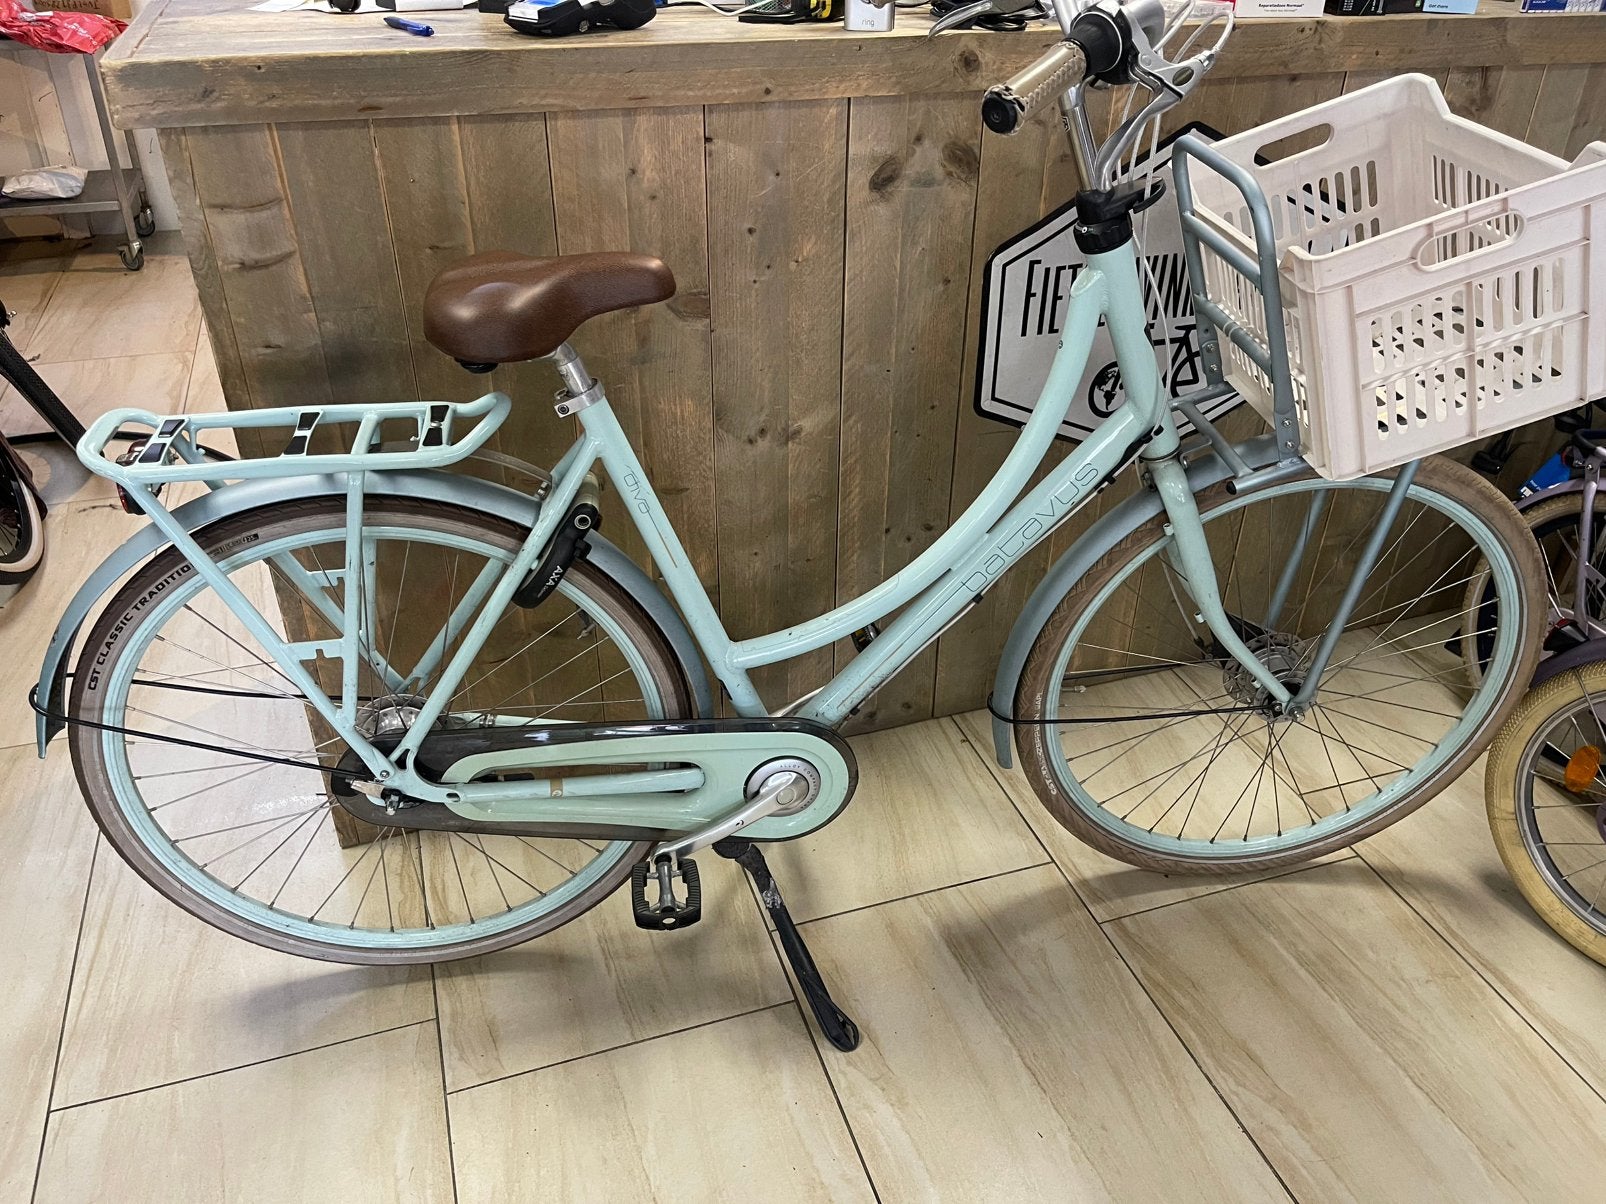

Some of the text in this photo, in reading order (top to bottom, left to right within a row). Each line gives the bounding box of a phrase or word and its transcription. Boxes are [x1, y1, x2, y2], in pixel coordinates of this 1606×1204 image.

[546, 565, 563, 586] AXA
[88, 561, 195, 691] CST CLASSIC TRADITIO
